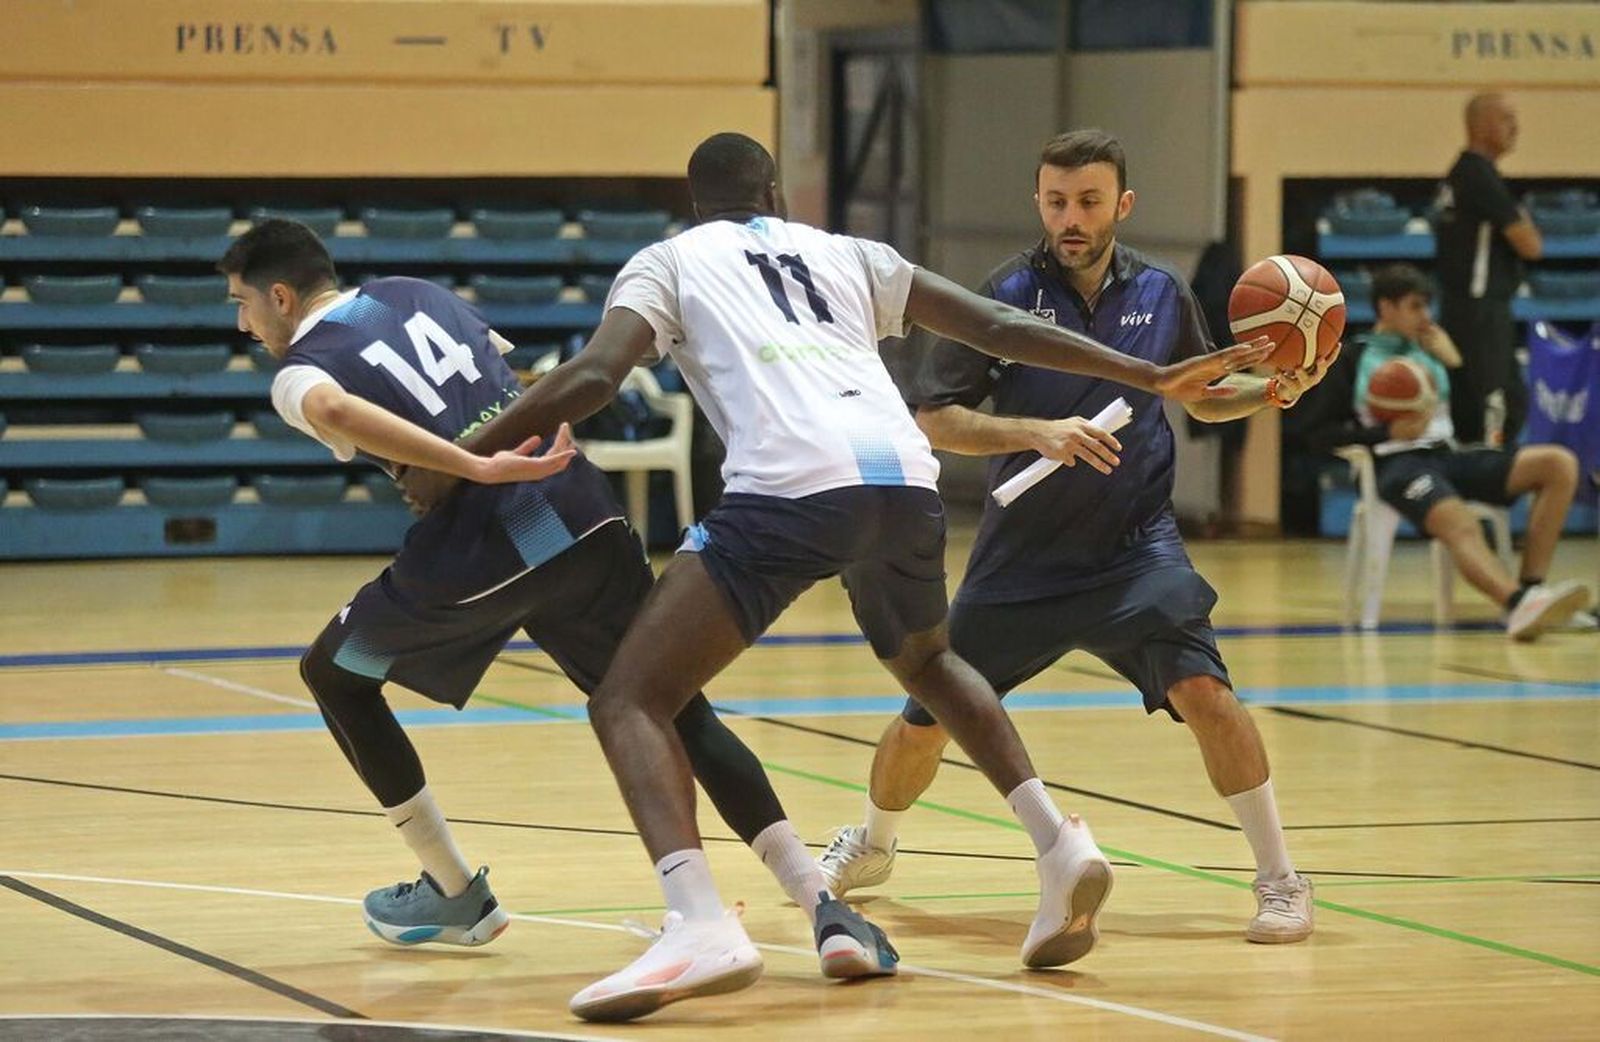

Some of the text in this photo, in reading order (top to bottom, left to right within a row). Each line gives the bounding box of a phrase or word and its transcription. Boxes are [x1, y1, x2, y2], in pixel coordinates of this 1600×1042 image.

[176, 24, 338, 53] PRENSA
[493, 24, 553, 53] TV
[1451, 30, 1596, 58] PRENSA
[744, 249, 835, 326] 11
[1120, 310, 1154, 328] vive
[359, 311, 483, 417] 14
